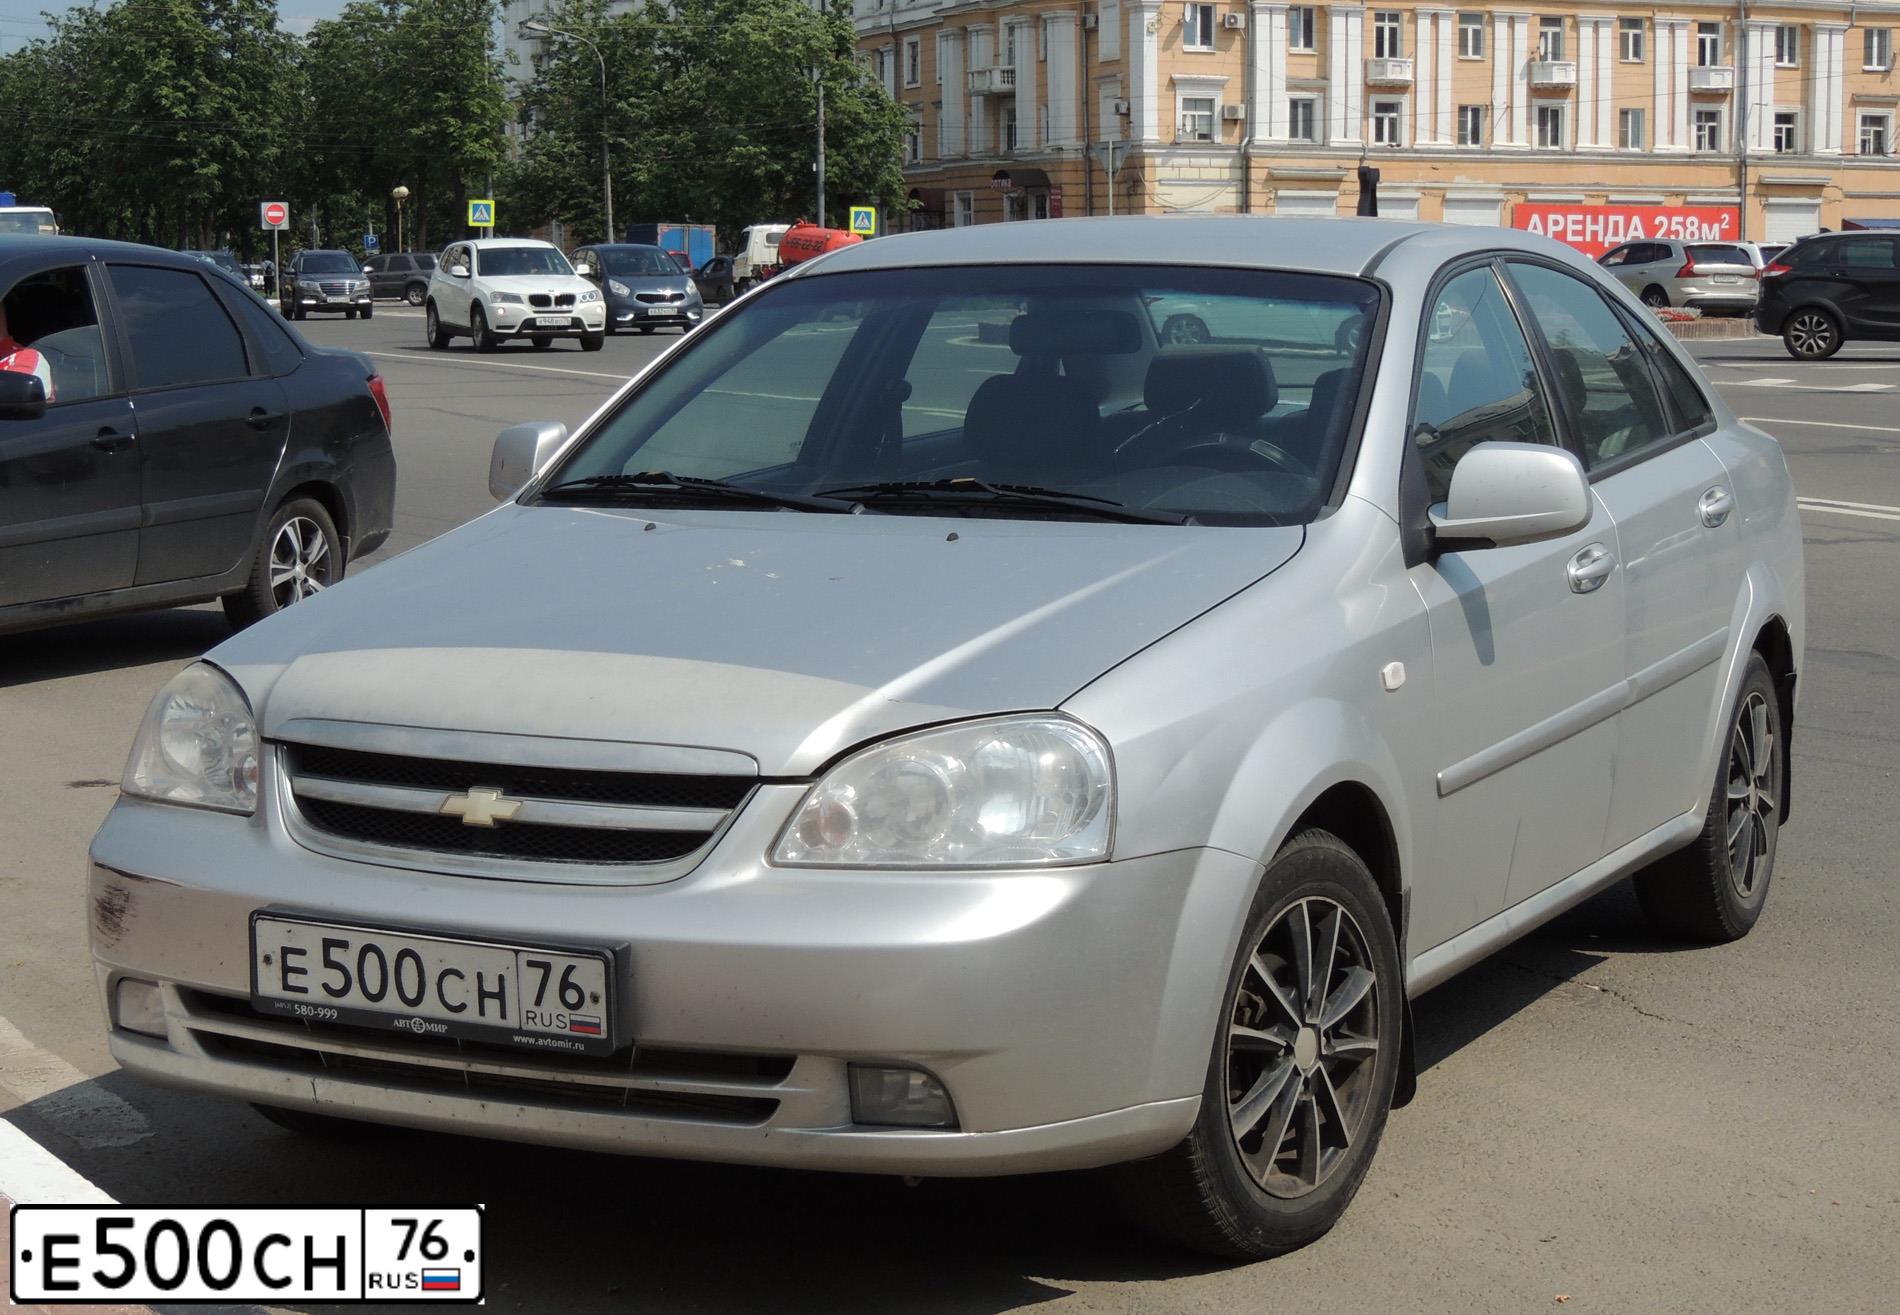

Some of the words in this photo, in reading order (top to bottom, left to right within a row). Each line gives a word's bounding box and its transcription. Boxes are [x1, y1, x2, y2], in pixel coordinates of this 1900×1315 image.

[1527, 213, 1645, 247] АРЕНДА
[526, 959, 586, 1011] 76
[294, 1003, 338, 1020] 580-999
[526, 1010, 568, 1030] RUS
[512, 1034, 585, 1051] www.avtomir.ru
